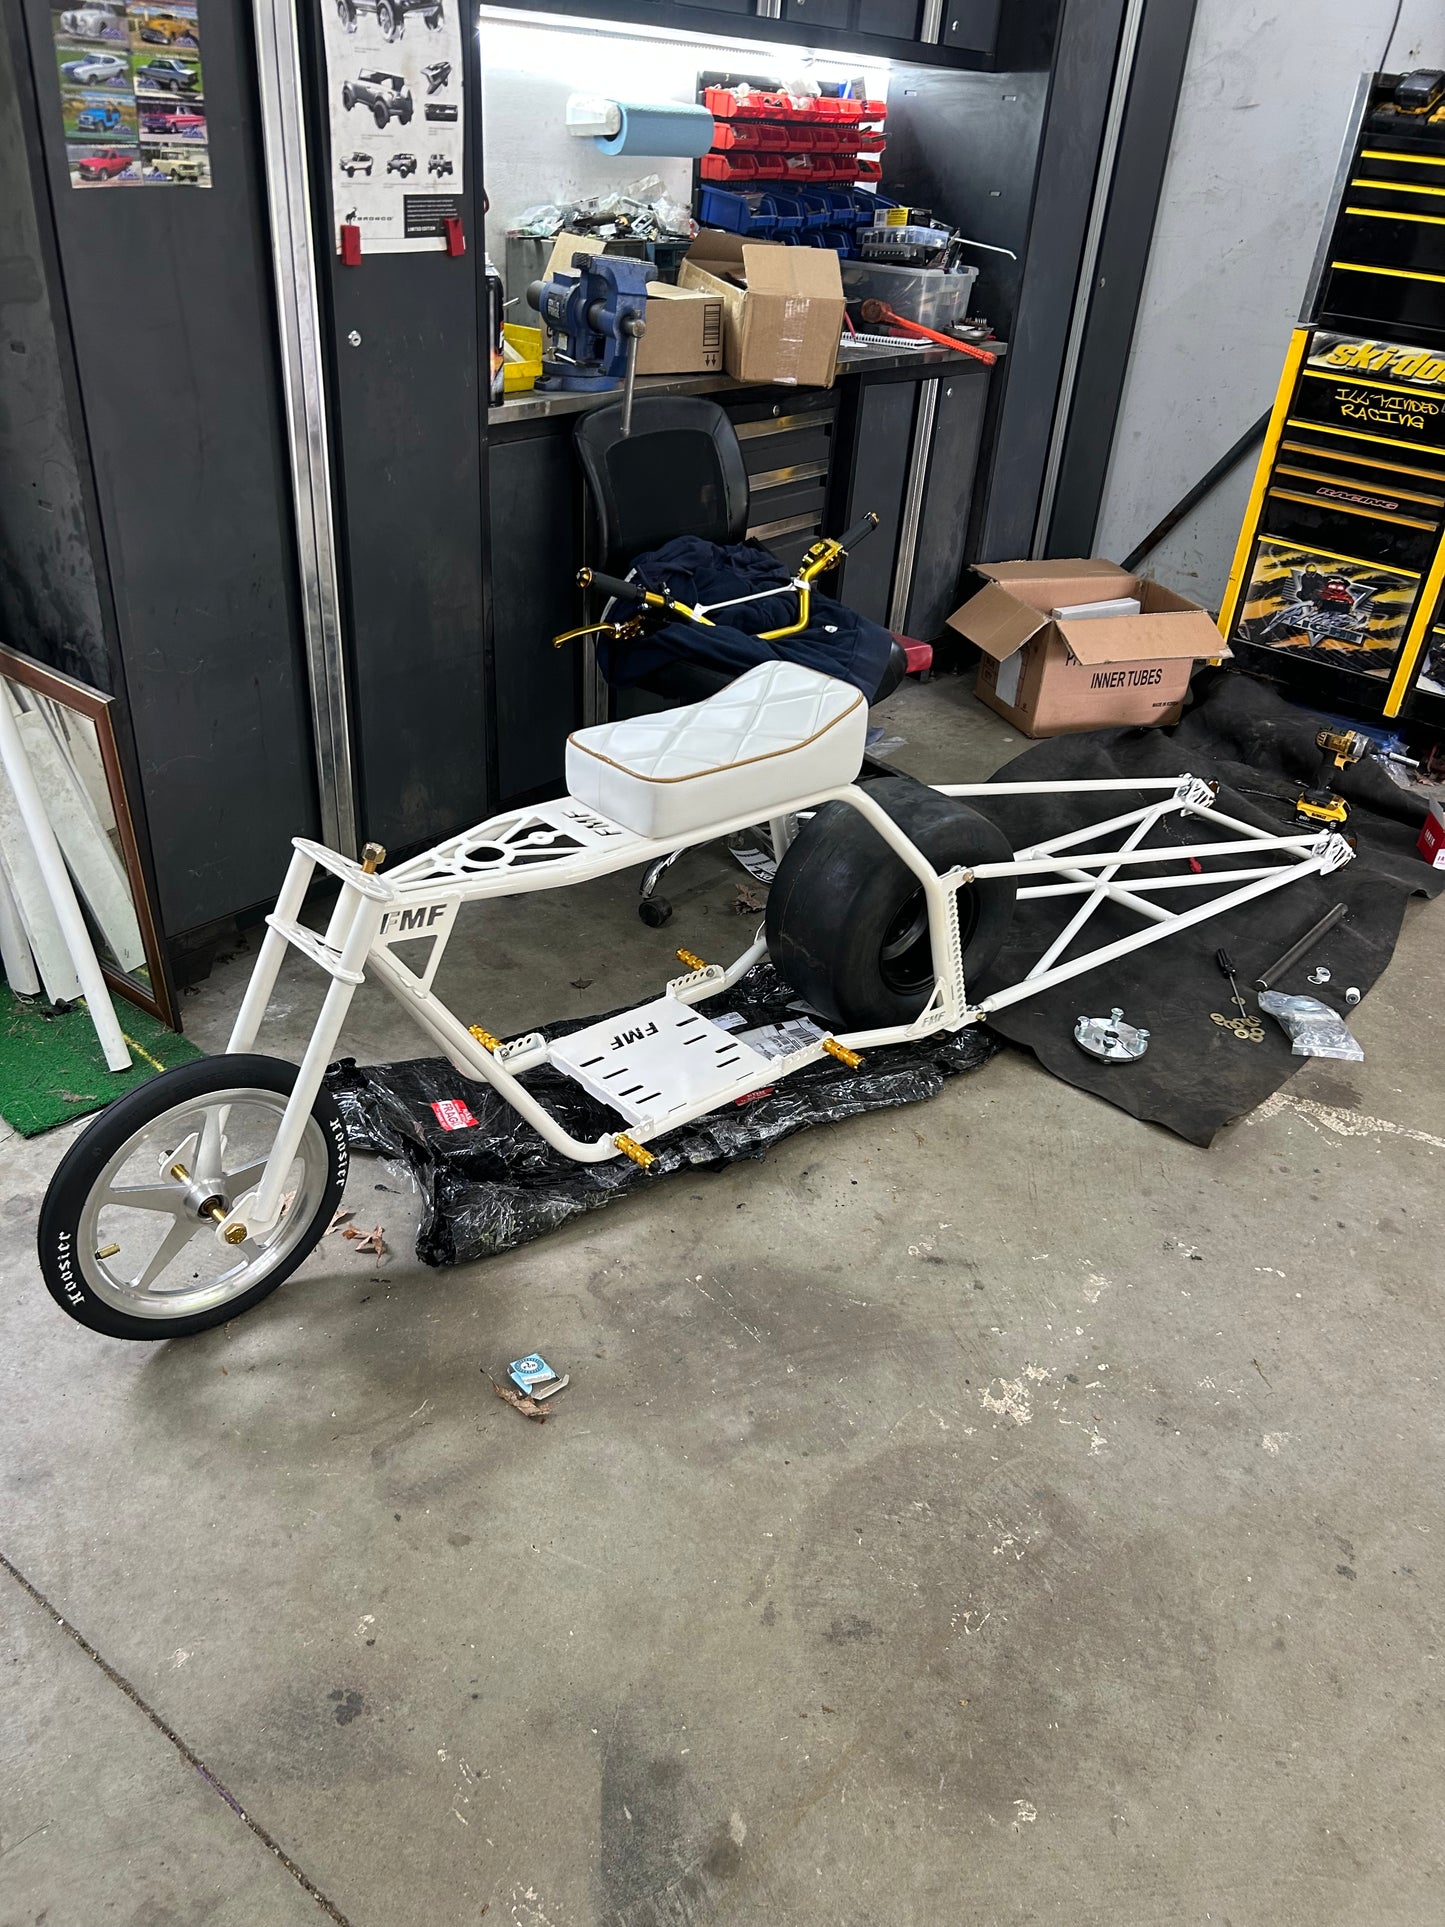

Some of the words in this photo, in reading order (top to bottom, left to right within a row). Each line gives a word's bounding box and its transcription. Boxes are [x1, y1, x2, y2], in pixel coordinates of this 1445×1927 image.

[1341, 404, 1425, 429] RACING
[1316, 487, 1399, 510] RACING
[1090, 671, 1126, 689] INNER
[1128, 668, 1163, 687] TUBES
[380, 903, 448, 935] FMF
[921, 1010, 946, 1028] FMF
[610, 1021, 659, 1051] FMF
[329, 1117, 348, 1187] Hoosier
[57, 1231, 86, 1307] Hoosier
